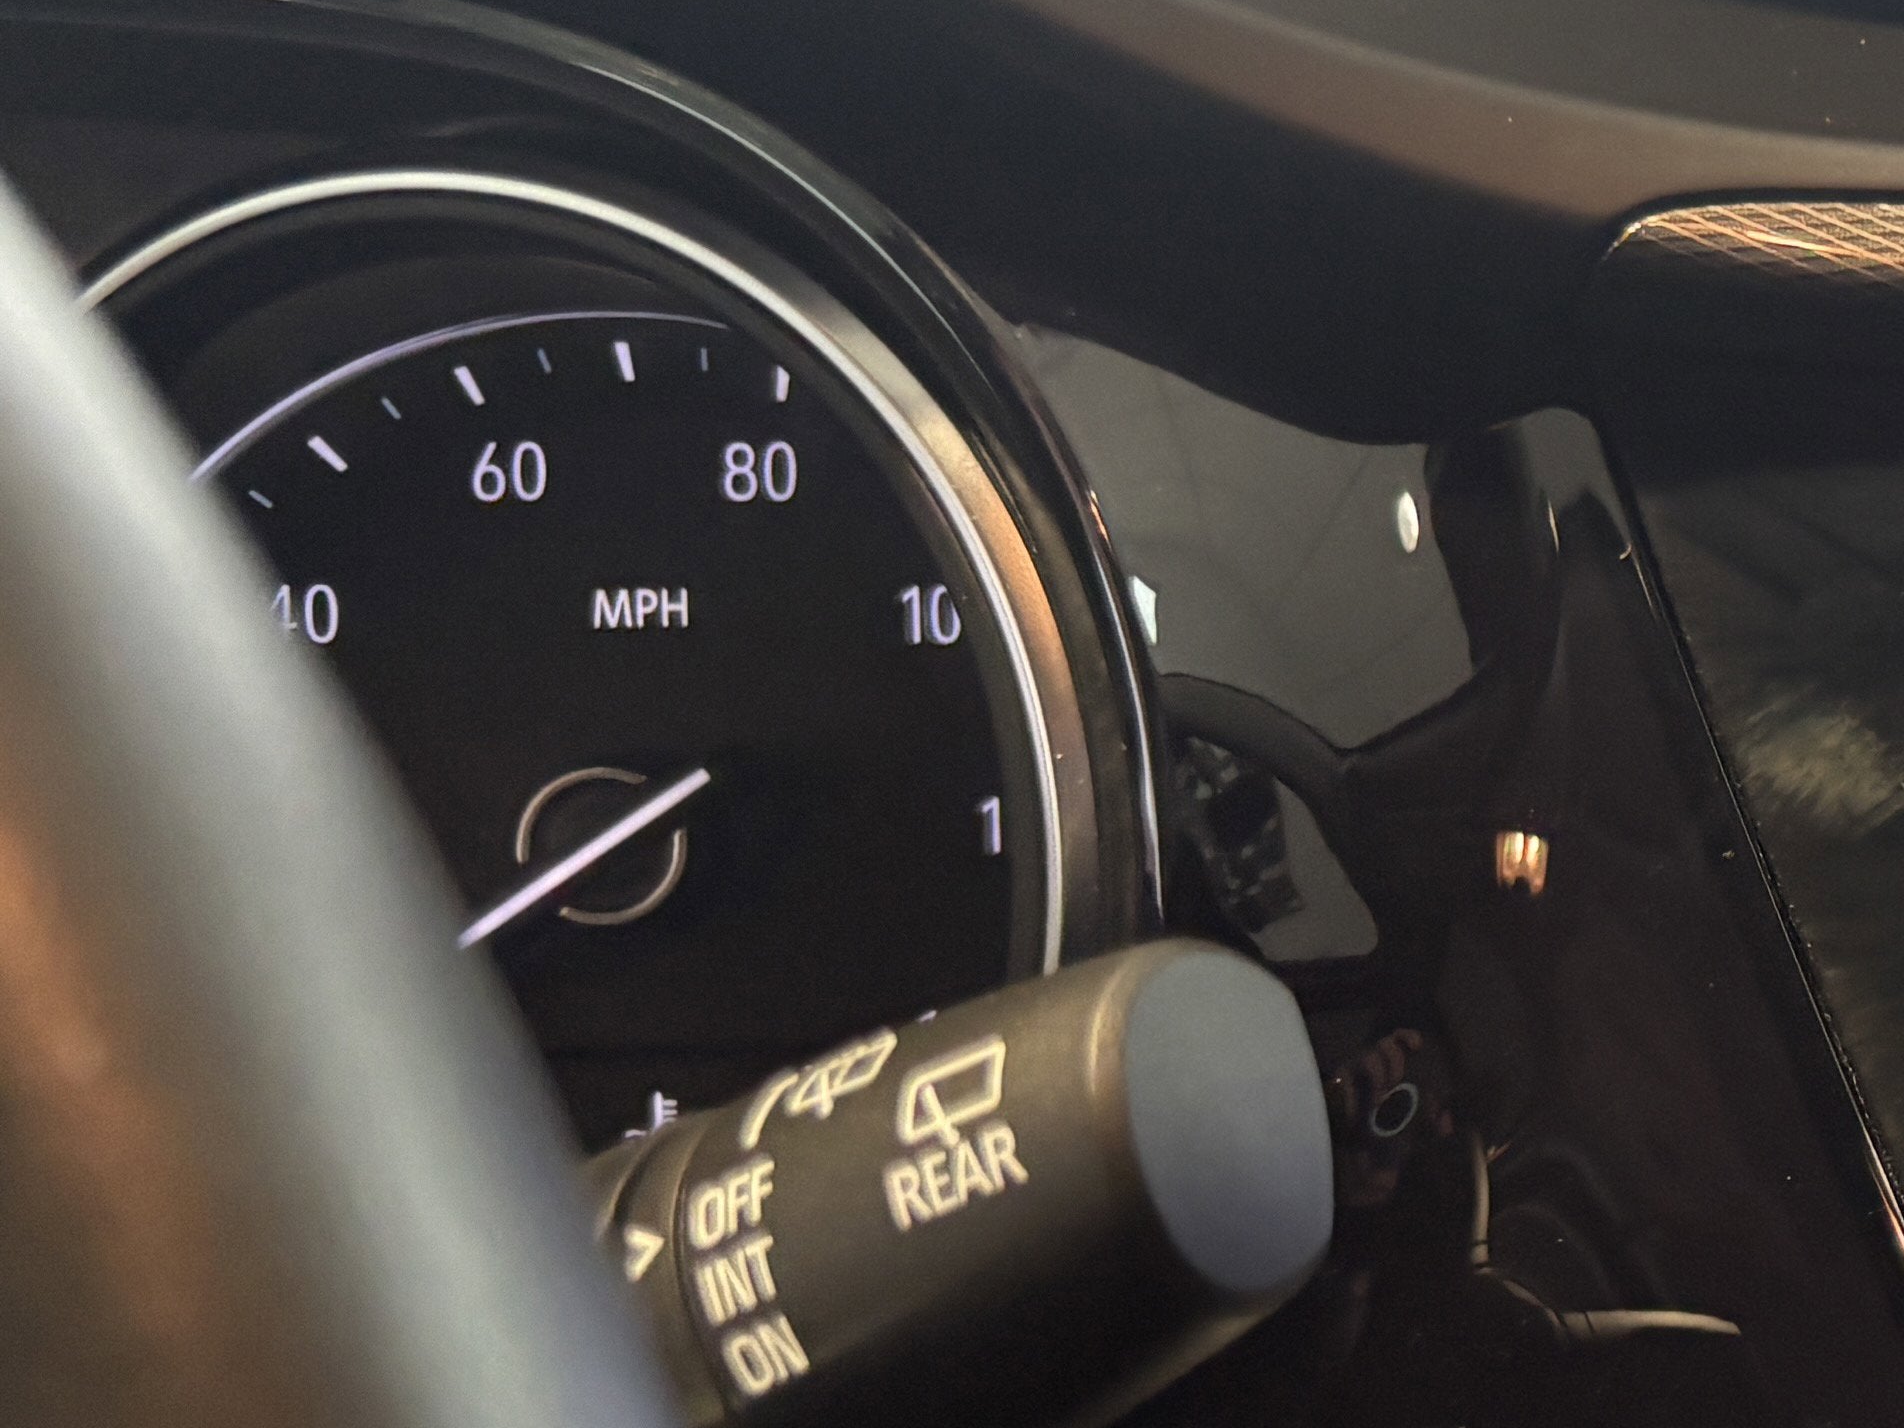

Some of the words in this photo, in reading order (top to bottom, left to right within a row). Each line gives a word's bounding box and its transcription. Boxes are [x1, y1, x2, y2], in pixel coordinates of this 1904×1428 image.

[471, 440, 548, 503] 60
[721, 439, 798, 503] 80
[592, 587, 690, 630] MPH
[688, 1153, 775, 1250] OFF
[883, 1123, 1029, 1232] REAR
[695, 1231, 777, 1327] INT
[722, 1312, 811, 1397] ON
